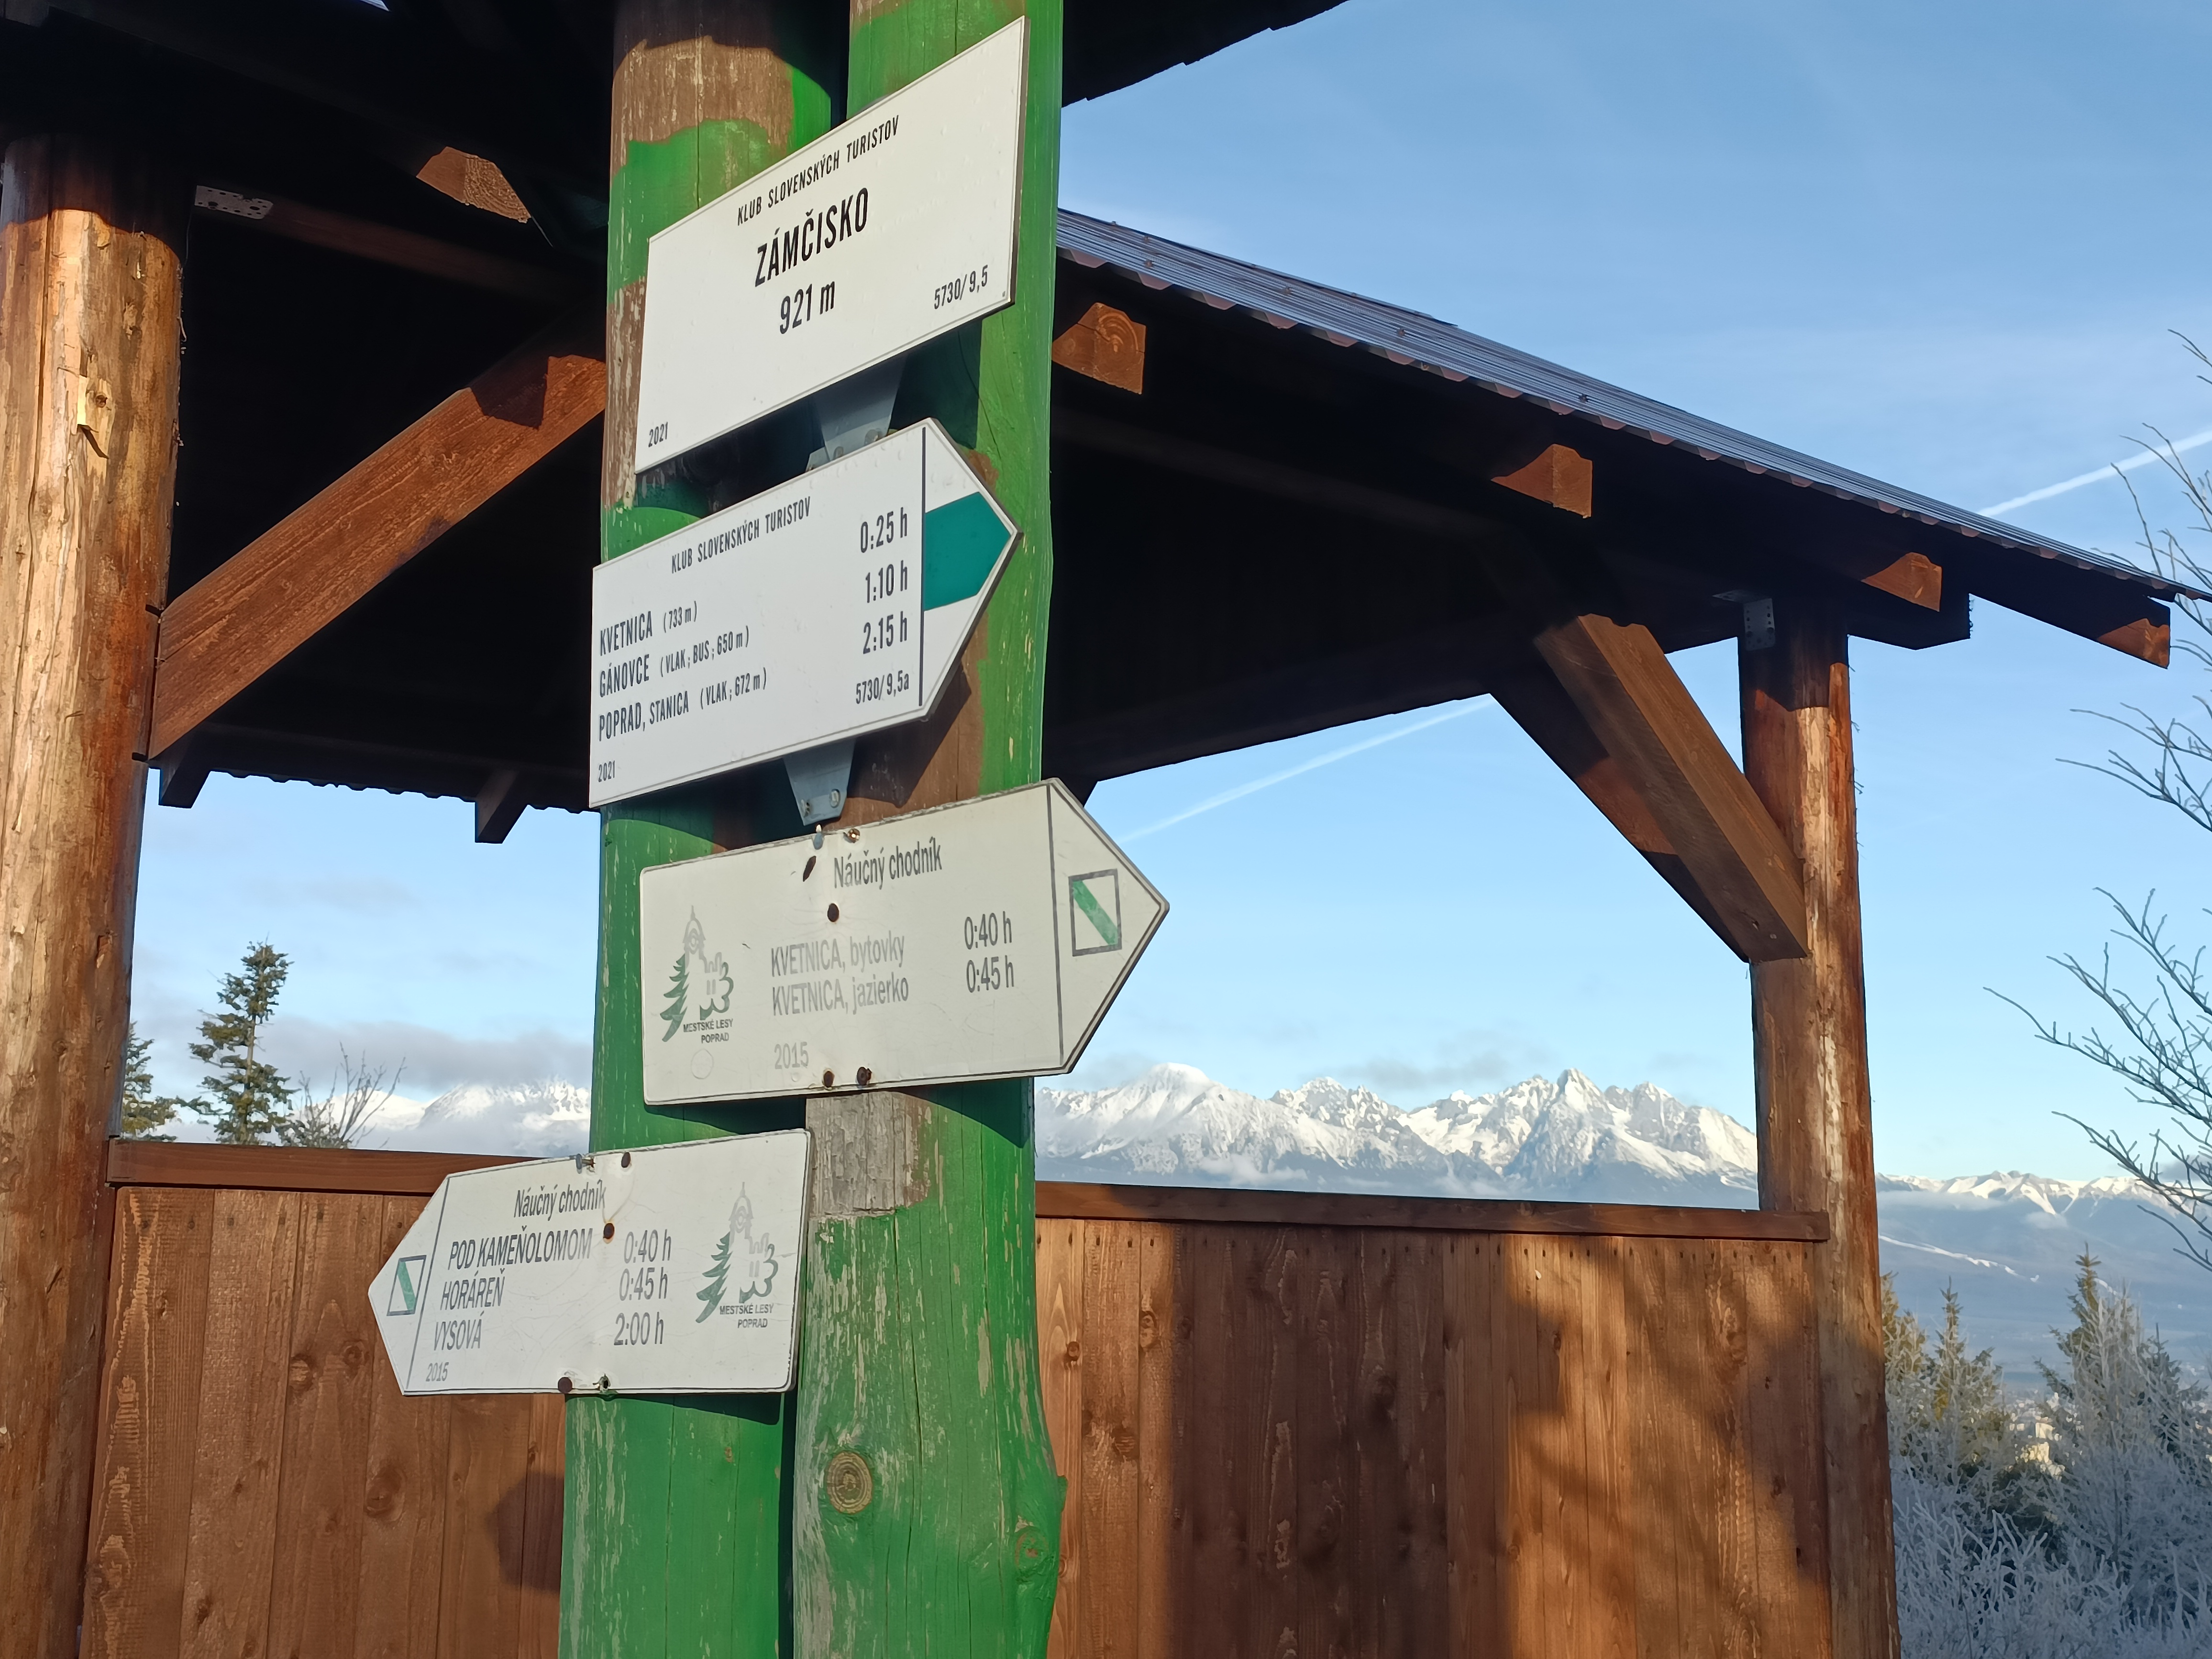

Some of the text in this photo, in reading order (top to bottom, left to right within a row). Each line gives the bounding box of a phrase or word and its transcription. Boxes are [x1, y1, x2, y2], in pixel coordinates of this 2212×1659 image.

[738, 115, 898, 226] KLUB SLOVENSKÝCH TURISTOV
[755, 186, 868, 287] ZÁMČISKO
[780, 281, 835, 334] 921 m
[648, 421, 668, 447] 2021
[672, 496, 810, 574] KLUB SLOVENSKÝCH TURISTOV
[600, 611, 652, 656] KVETNICA
[861, 511, 894, 553] 0:25
[900, 507, 907, 538] h
[600, 654, 649, 697] GÁNOVCE
[717, 631, 733, 655] 650
[865, 564, 894, 603] 1:10
[900, 560, 907, 591] h
[599, 702, 645, 741] POPRAD,
[650, 691, 688, 724] STANICA
[735, 673, 750, 696] 672
[863, 614, 894, 654] 2:15
[900, 611, 907, 642] h
[598, 761, 615, 782] 2021
[834, 836, 942, 890] Náučný chodník
[772, 911, 1012, 977] KVETNICA, bytovky 0:40 h
[773, 955, 1014, 1016] KVETNICA, jazierko 0:45 h
[683, 1018, 733, 1032] MESTSKÉ LESY
[701, 1032, 729, 1043] POPRAD
[774, 1042, 808, 1069] 2015
[514, 1179, 606, 1221] Náučný chodník
[448, 1225, 671, 1270] POD KAMEŇOLOMOM 0:40 h
[440, 1267, 667, 1310] HORÁREŇ 0:45 h
[719, 1303, 774, 1315] MESTSKÉ LESY
[434, 1311, 664, 1350] VYSOVÁ 2:00 h
[738, 1318, 767, 1328] POPRAD
[426, 1362, 449, 1382] 2015
